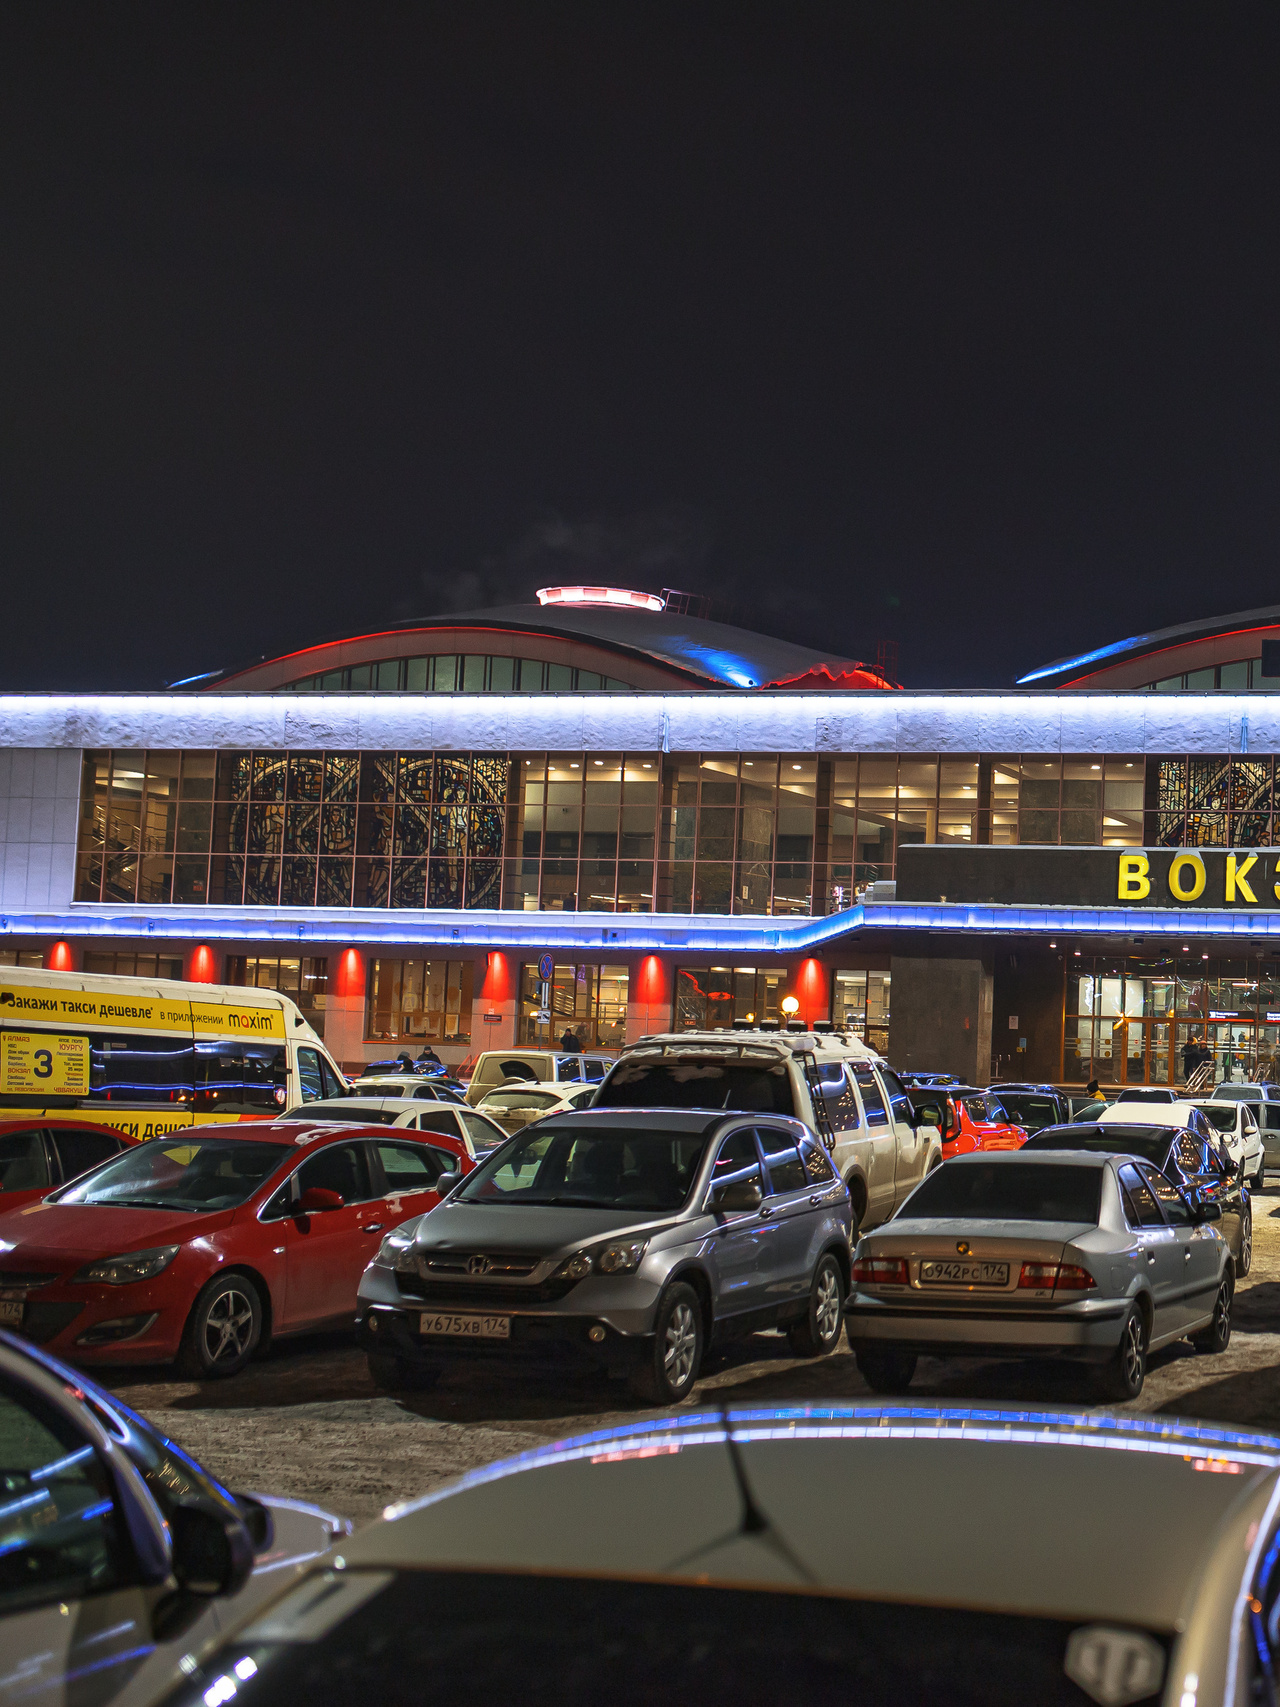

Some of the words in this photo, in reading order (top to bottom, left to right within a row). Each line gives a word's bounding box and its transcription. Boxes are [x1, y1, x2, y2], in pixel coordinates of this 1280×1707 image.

[61, 1000, 96, 1014] такси
[160, 1011, 165, 1020] в
[168, 1012, 223, 1025] приложении
[33, 1049, 53, 1078] 3
[426, 1315, 480, 1334] У675ХВ
